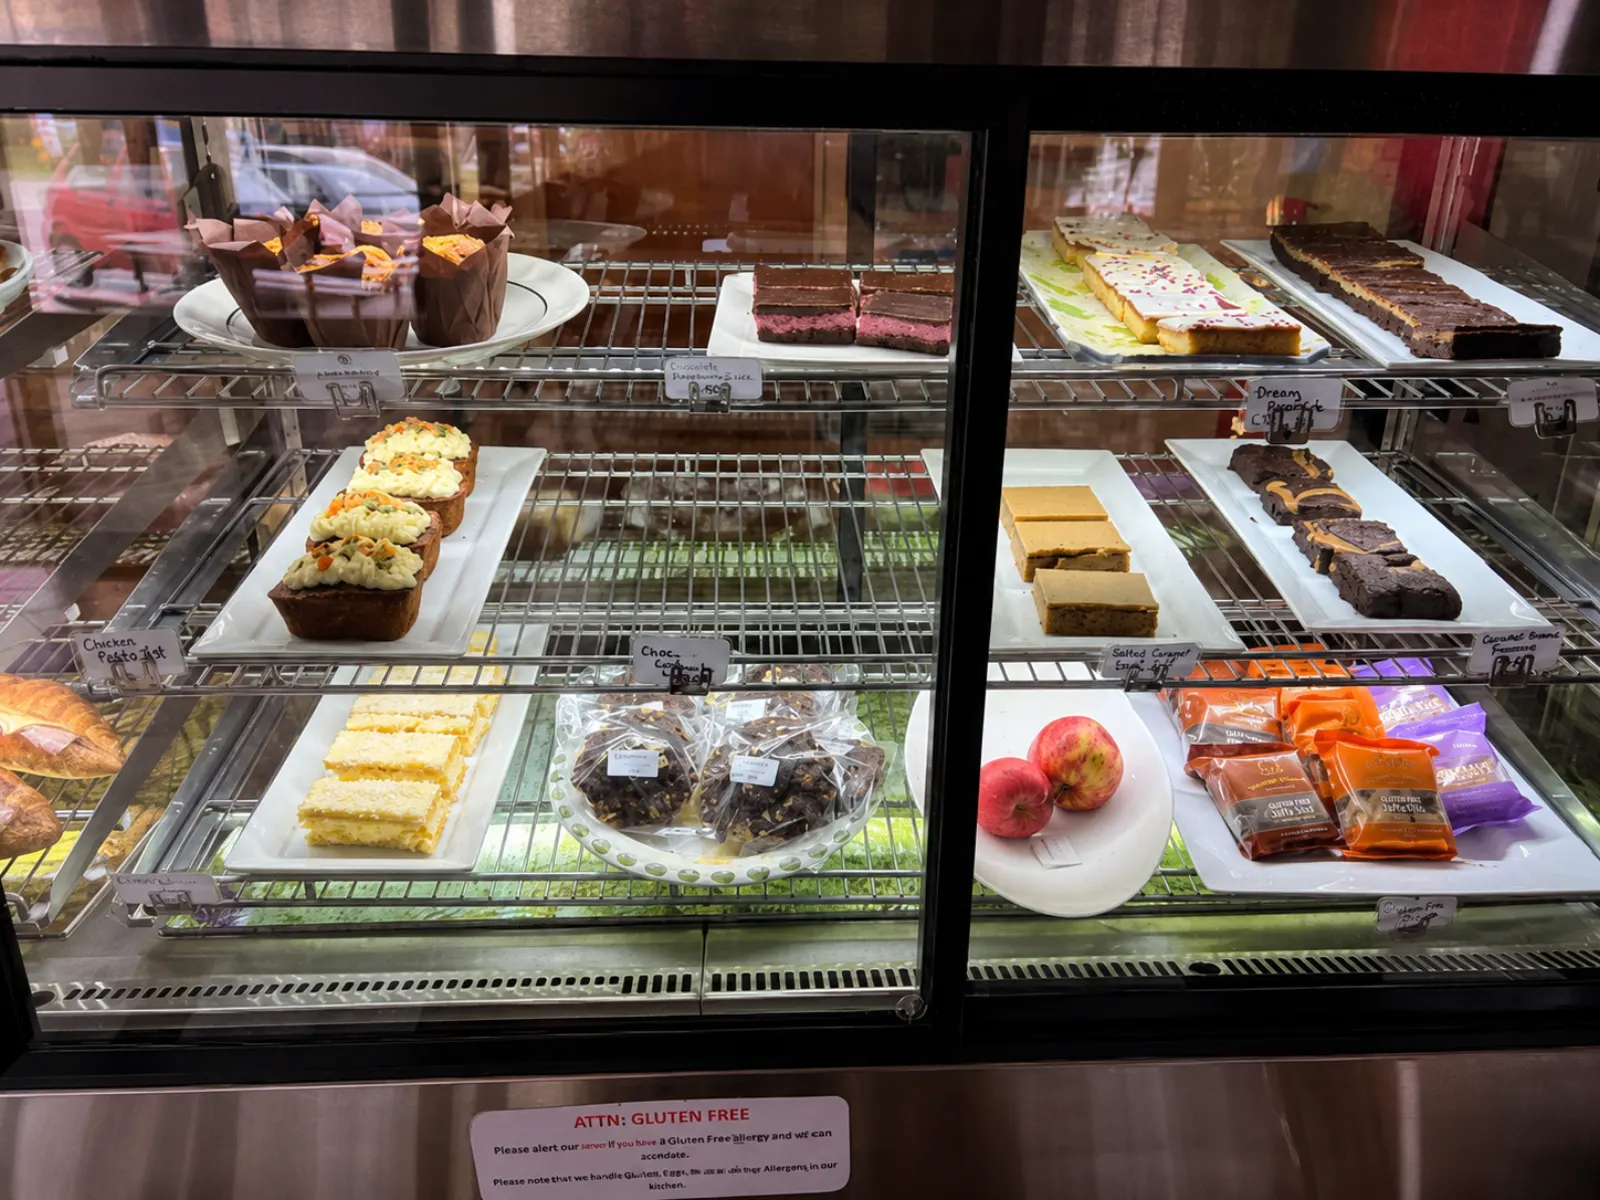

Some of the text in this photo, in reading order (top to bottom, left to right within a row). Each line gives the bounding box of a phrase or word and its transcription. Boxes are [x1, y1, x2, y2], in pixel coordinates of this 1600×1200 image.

[1256, 386, 1302, 402] Dream
[83, 637, 137, 652] Chicken
[1112, 648, 1146, 658] Salted
[574, 1107, 750, 1129] ATTN: GLUTEN FREE
[494, 1145, 530, 1155] Please
[532, 1143, 559, 1153] alert
[560, 1143, 580, 1151] our
[617, 1140, 634, 1149] you
[659, 1137, 666, 1146] a
[667, 1135, 705, 1145] Gluten
[707, 1134, 731, 1143] Free
[732, 1133, 770, 1144] allergy
[771, 1131, 792, 1140] and
[795, 1131, 808, 1139] we
[811, 1130, 832, 1138] can
[493, 1178, 526, 1186] Please
[527, 1176, 550, 1184] note
[551, 1174, 572, 1183] that
[590, 1172, 623, 1181] handle
[809, 1162, 819, 1170] in
[820, 1161, 838, 1170] our
[649, 1182, 687, 1190] kitchen.
